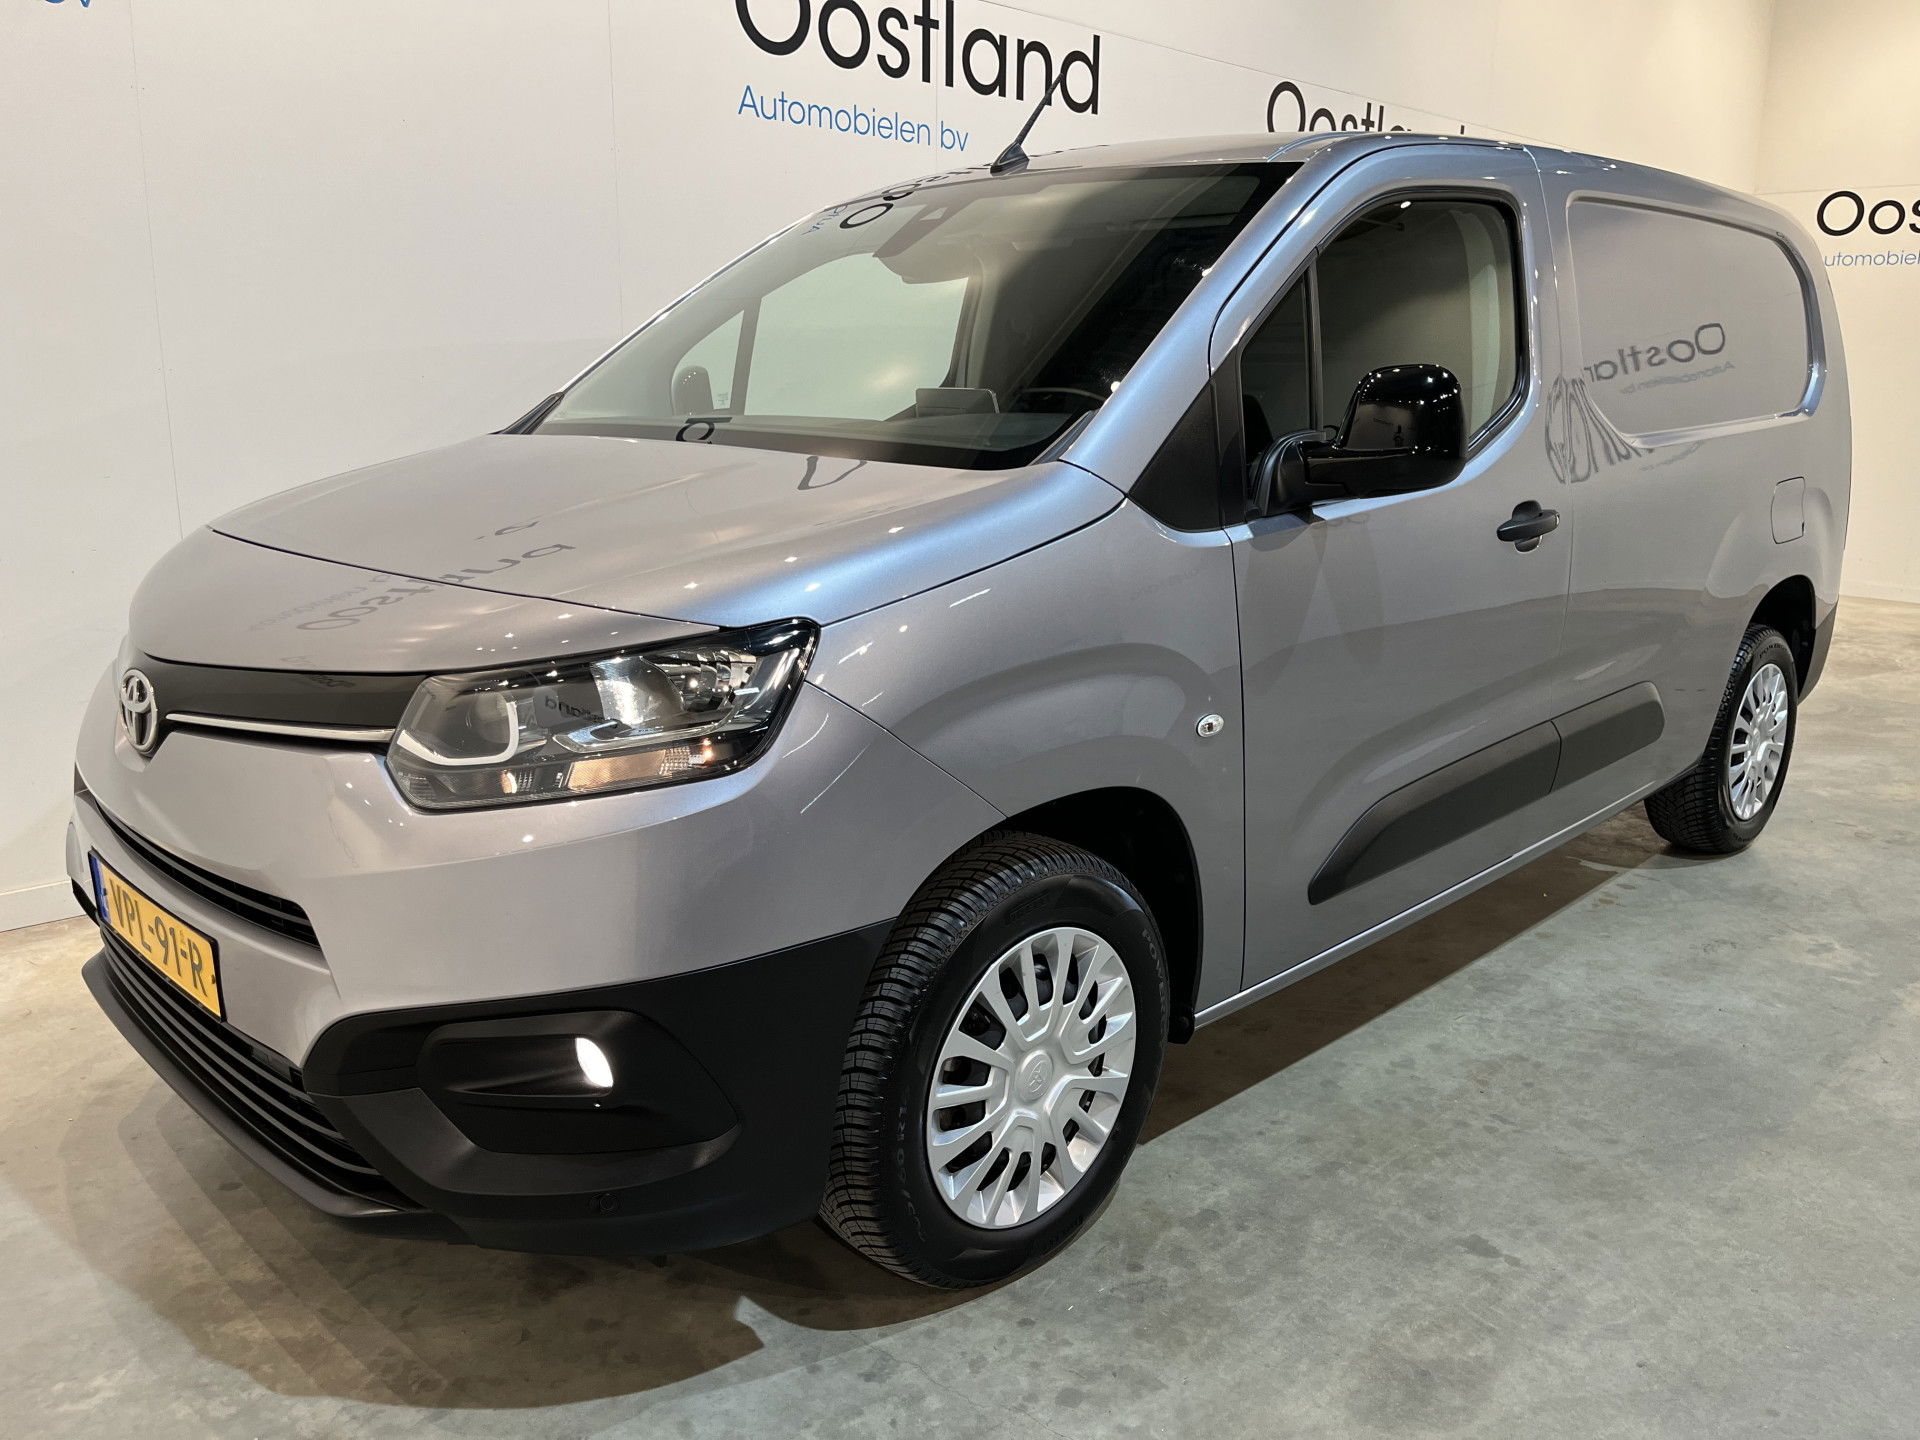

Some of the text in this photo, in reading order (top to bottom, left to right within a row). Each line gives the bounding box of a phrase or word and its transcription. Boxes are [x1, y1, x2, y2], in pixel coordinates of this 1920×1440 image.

[738, 84, 969, 152] Automobielen bv
[109, 878, 208, 997] VPL-91-R
